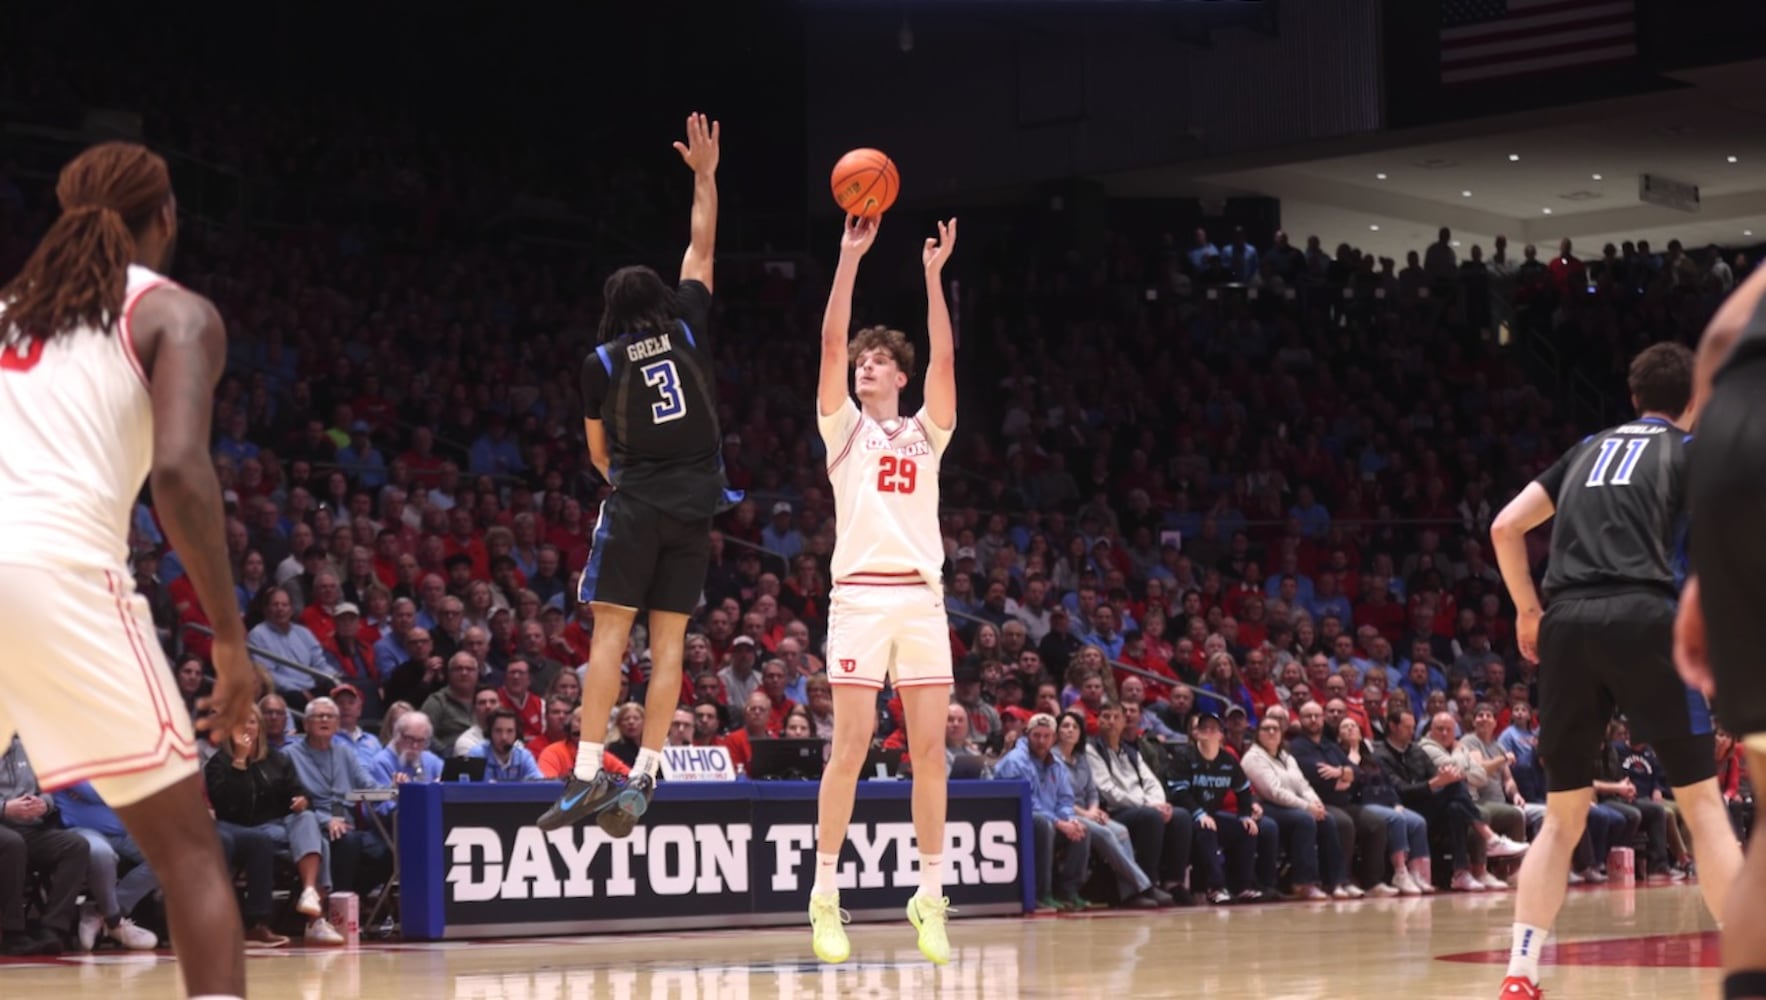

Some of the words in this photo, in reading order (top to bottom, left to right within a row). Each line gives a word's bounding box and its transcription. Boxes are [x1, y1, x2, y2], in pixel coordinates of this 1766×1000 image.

[626, 333, 672, 362] GREEN
[640, 359, 687, 424] 3
[866, 440, 929, 457] DATON
[1585, 438, 1650, 487] 11
[877, 456, 916, 494] 29
[663, 749, 726, 771] WHIO
[444, 824, 752, 902] DAYTON
